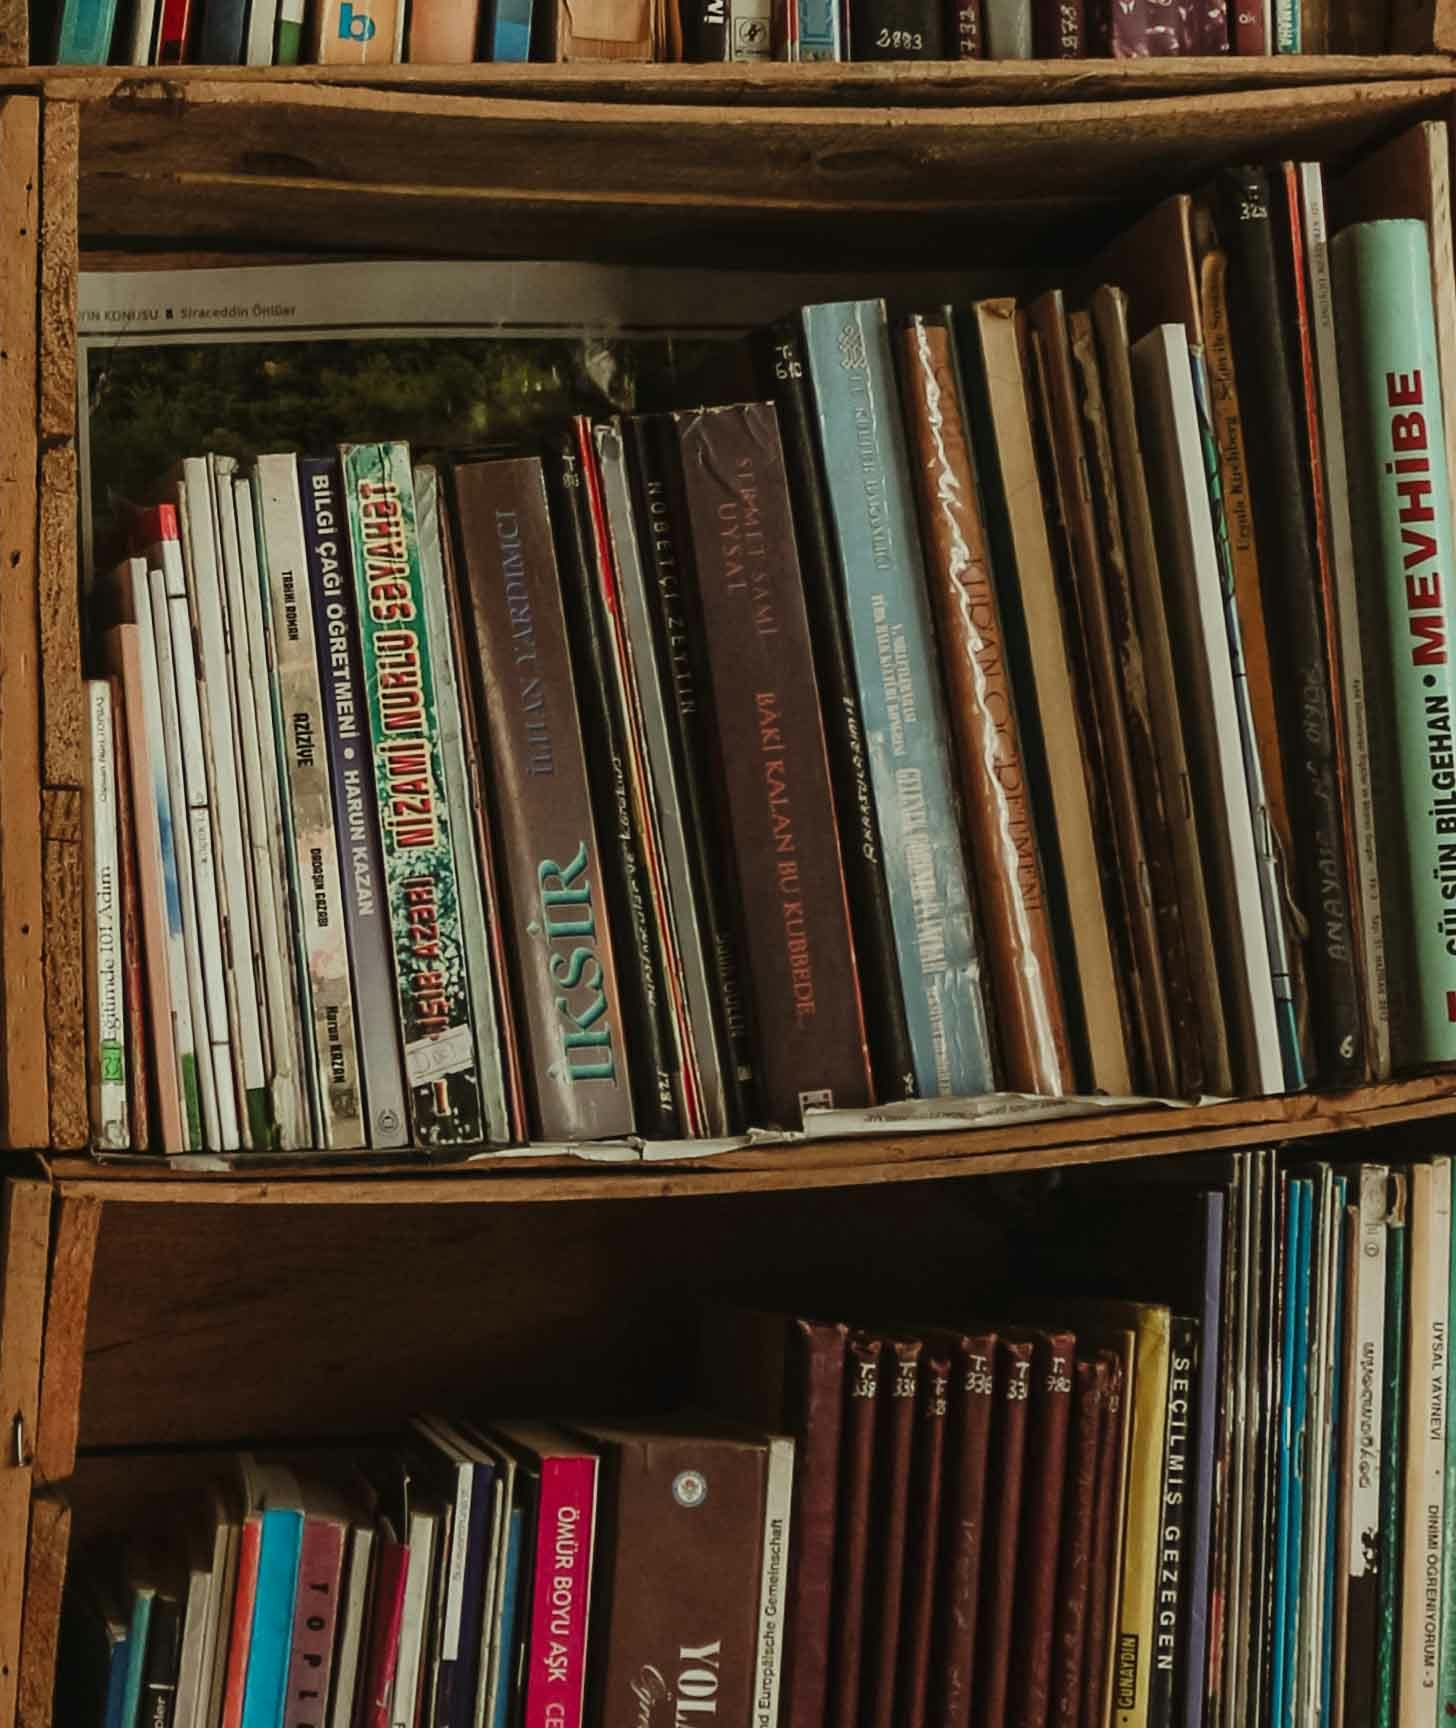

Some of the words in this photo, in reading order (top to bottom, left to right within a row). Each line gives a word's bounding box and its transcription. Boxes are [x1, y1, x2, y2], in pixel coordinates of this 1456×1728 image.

[311, 475, 336, 536] BİLGİ
[1385, 369, 1447, 665] MEVHİBE
[314, 542, 345, 598] ÇAĞI
[345, 770, 368, 840] HARUN
[350, 847, 375, 916] KAZAN
[528, 841, 621, 1087] İKSİR
[552, 1506, 581, 1568] ÖMÜR
[766, 1518, 785, 1616] Gemeinschaft
[549, 1575, 574, 1635] BOYU
[1156, 1526, 1185, 1671] GEZEGEN
[544, 1642, 570, 1683] AŞK
